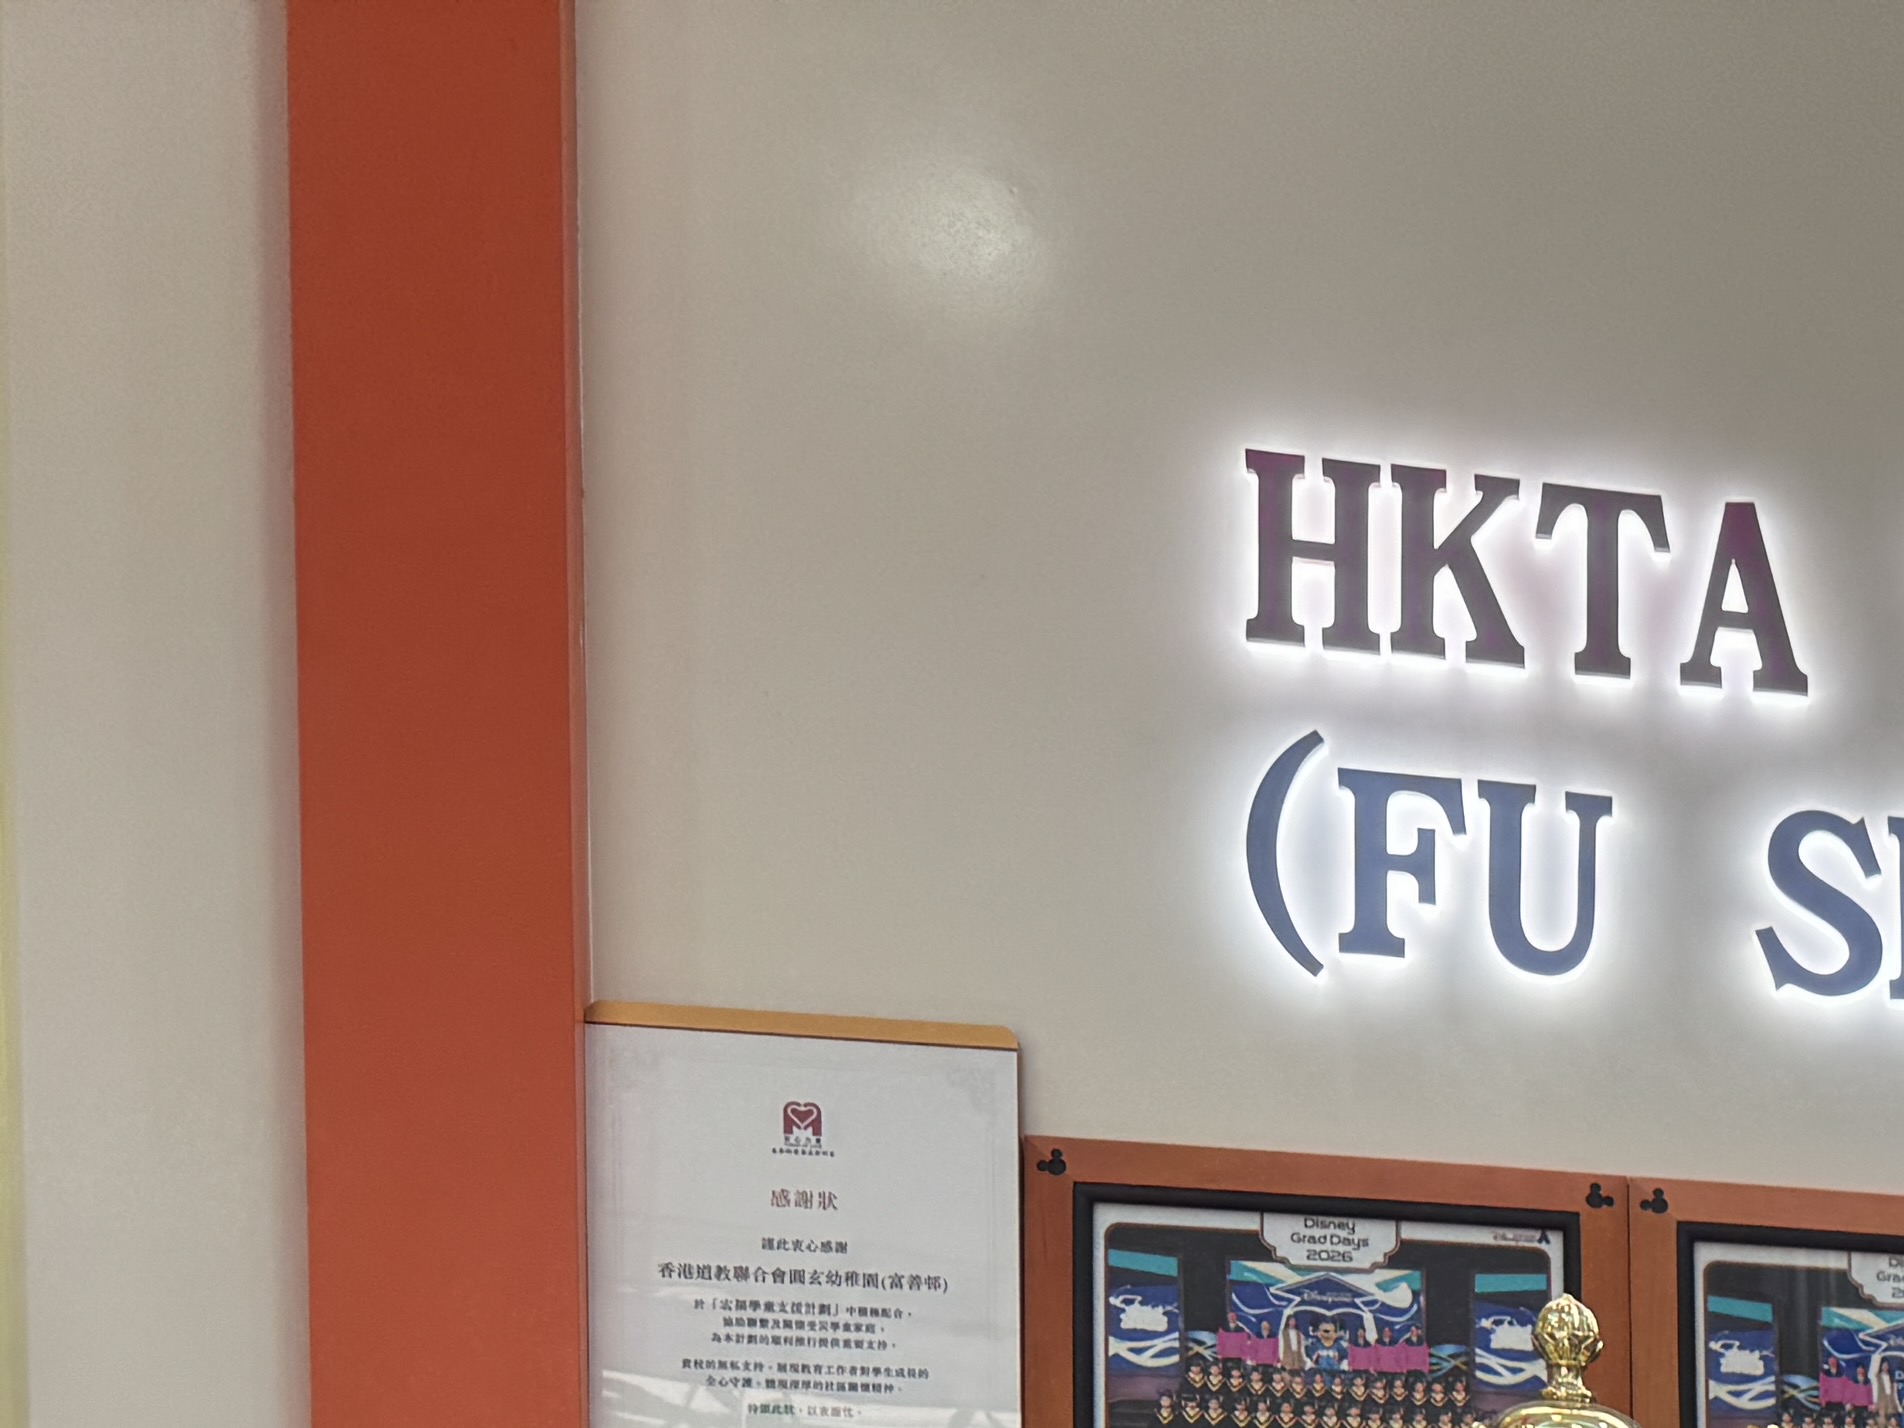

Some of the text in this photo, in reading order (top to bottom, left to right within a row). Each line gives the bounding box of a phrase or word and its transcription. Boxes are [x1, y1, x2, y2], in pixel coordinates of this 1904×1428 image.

[1244, 448, 1809, 697] HKTA
[1245, 729, 1612, 977] (FU
[770, 1188, 839, 1211] 感謝狀
[1303, 1217, 1356, 1235] Disney
[1290, 1231, 1369, 1252] Grad Days
[1305, 1249, 1354, 1263] 2026
